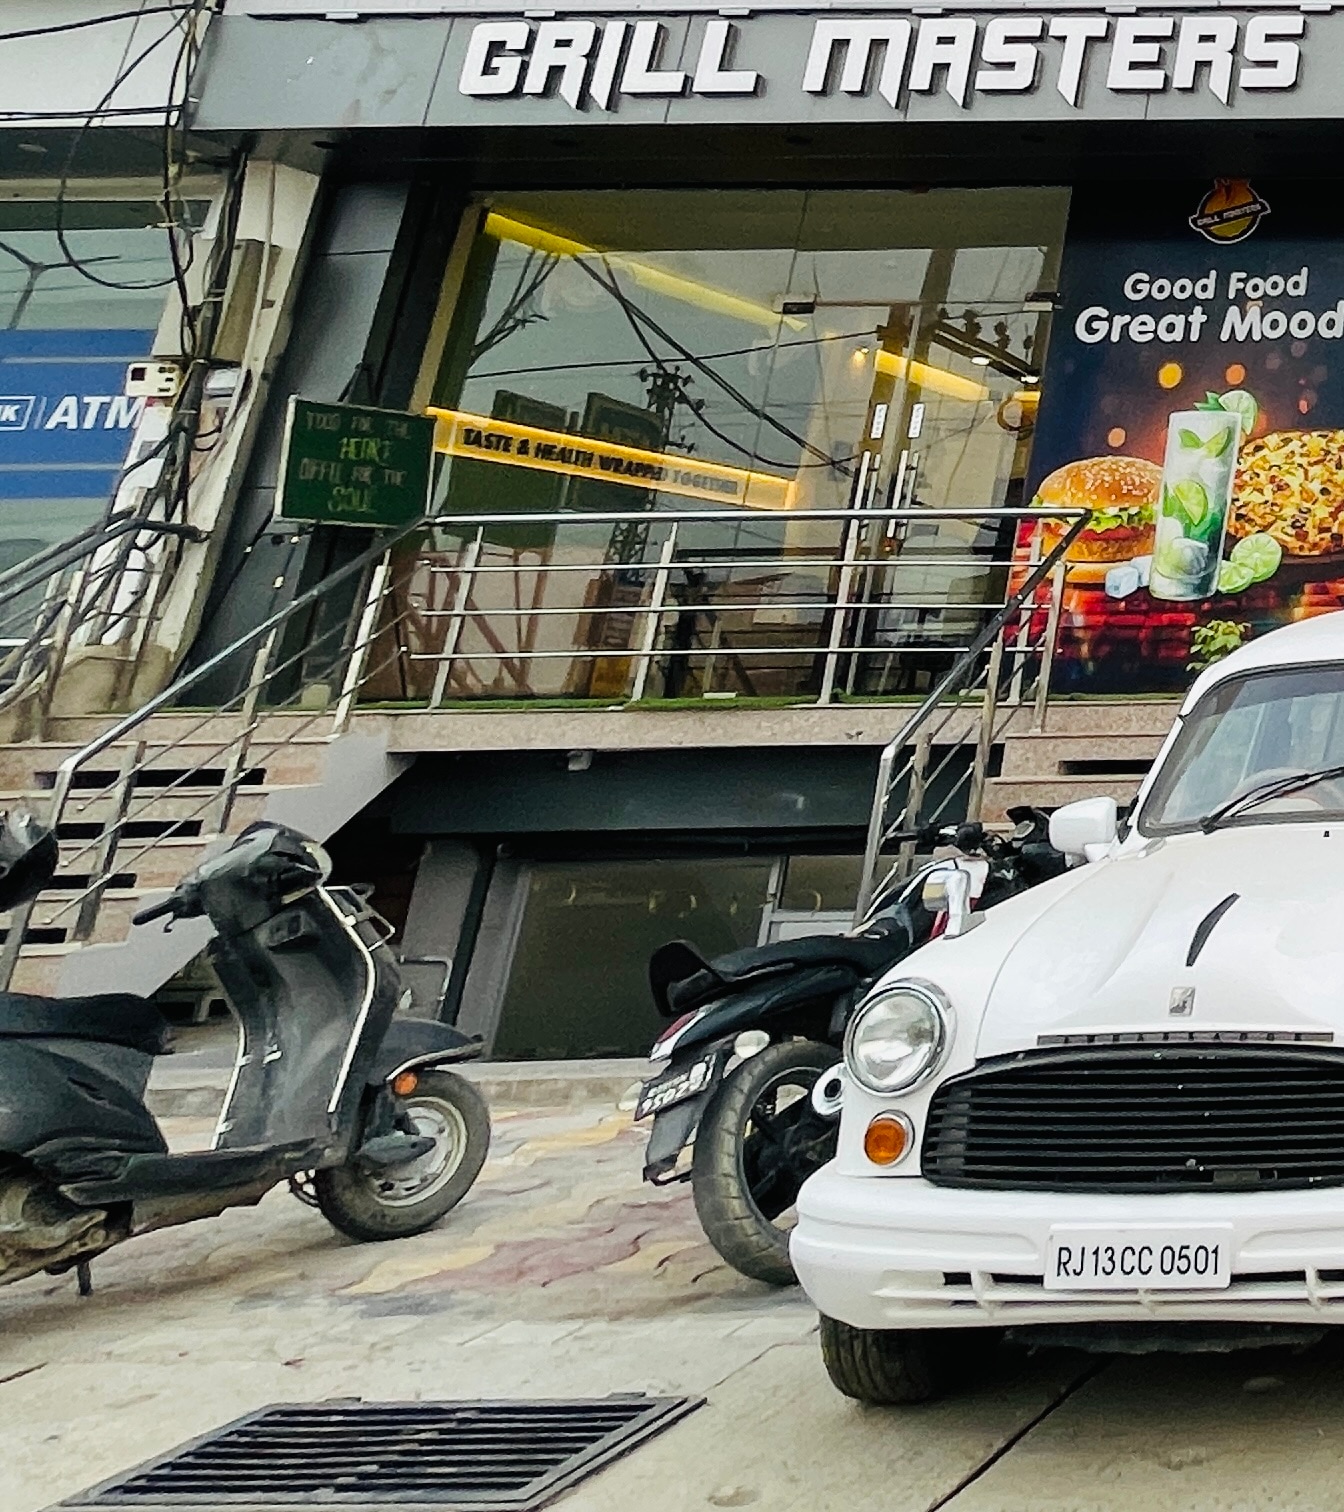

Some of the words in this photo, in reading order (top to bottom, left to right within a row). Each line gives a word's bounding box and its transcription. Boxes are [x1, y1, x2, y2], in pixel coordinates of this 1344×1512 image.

[458, 20, 758, 110] GRILL
[802, 16, 1305, 109] MASTERS
[1123, 269, 1218, 301] Good
[1227, 266, 1309, 300] Food
[1075, 305, 1207, 343] Great
[0, 404, 19, 422] K
[44, 396, 148, 430] ATM
[1160, 1245, 1219, 1276] 0501
